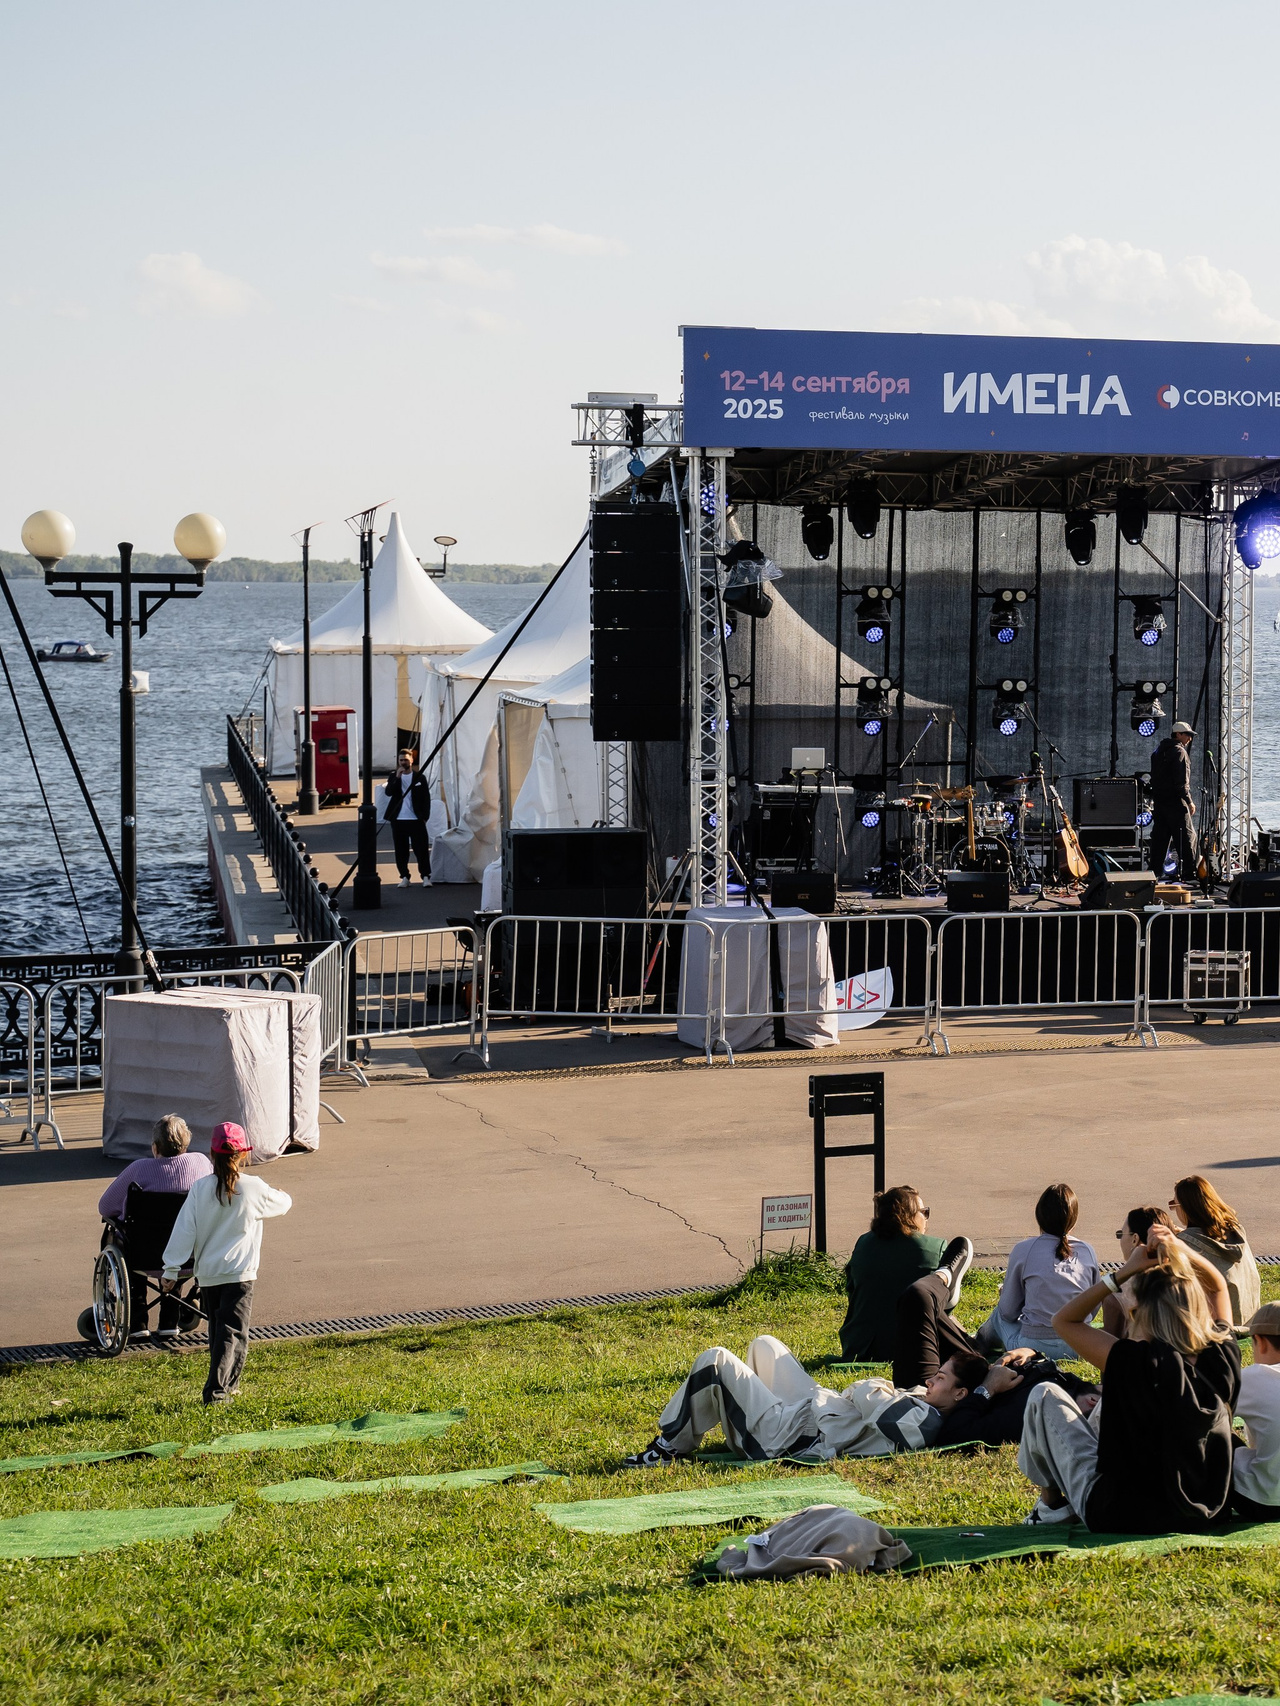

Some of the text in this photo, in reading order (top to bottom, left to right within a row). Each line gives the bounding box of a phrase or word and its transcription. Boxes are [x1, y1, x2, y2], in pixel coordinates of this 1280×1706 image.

[792, 371, 910, 403] сентября
[943, 371, 1132, 416] ИМЕНА
[723, 398, 784, 420] 2025
[808, 406, 909, 425] фестиваль музыки
[776, 1202, 808, 1212] ГАЗОНАМ
[778, 1214, 806, 1223] ХОДИТЬ!
